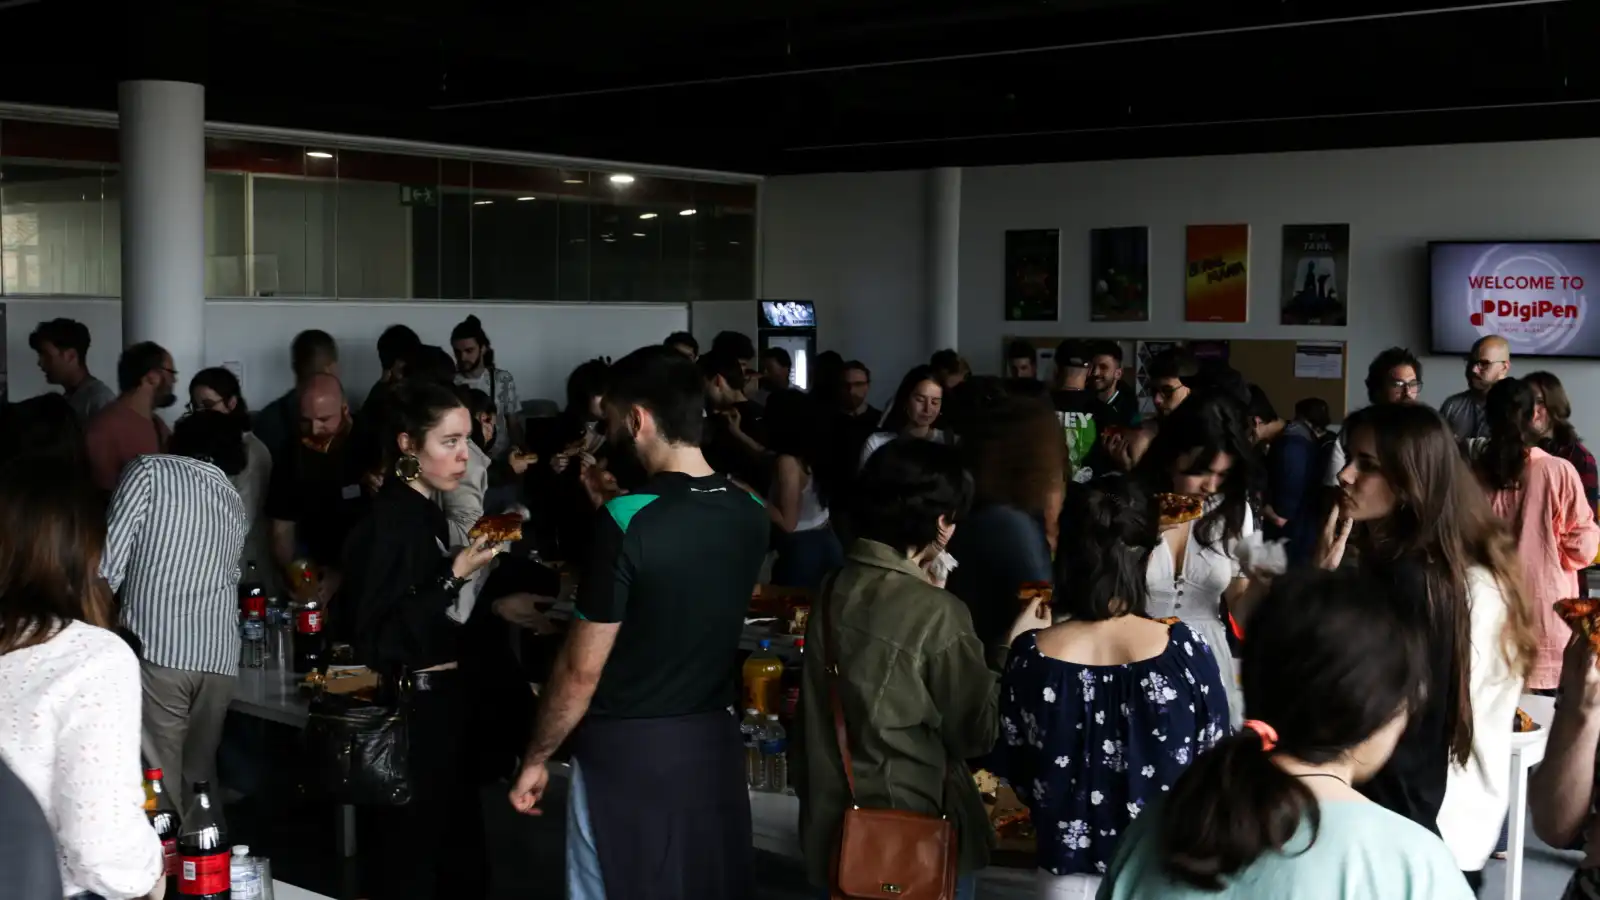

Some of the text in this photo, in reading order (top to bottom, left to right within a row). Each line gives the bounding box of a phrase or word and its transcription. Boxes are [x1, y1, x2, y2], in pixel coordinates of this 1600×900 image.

[1468, 275, 1584, 290] WELCOME TO
[1497, 300, 1578, 322] DigiPen
